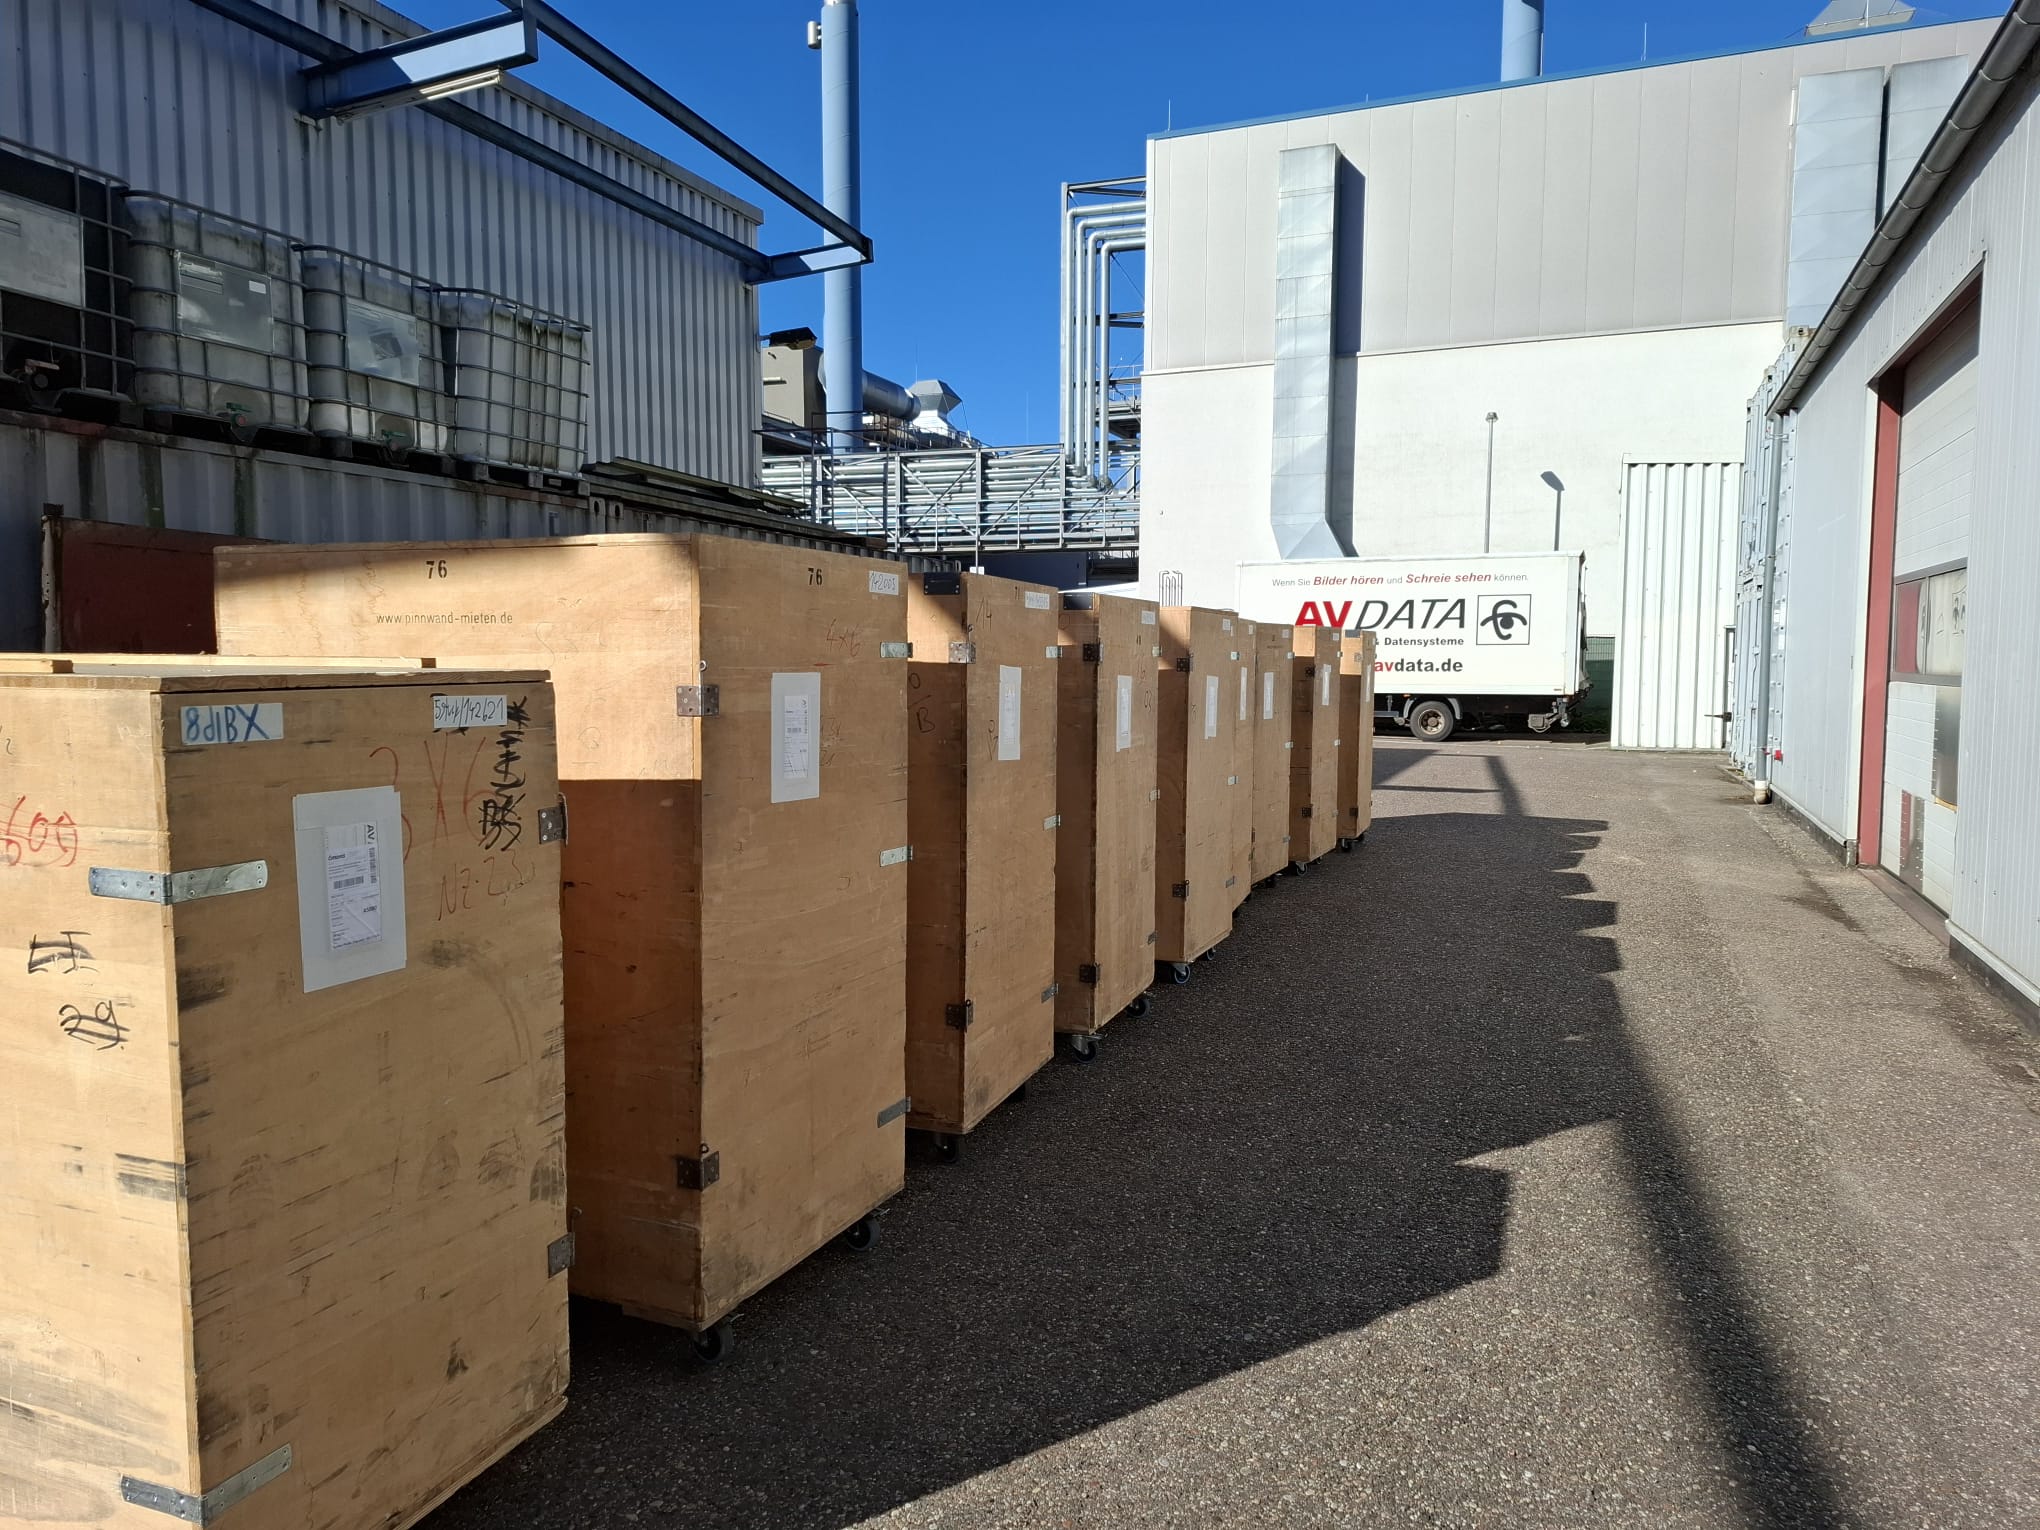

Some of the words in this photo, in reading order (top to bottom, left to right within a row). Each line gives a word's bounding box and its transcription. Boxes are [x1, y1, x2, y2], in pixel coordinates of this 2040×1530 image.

[426, 560, 447, 579] 76
[808, 567, 823, 586] 76
[1272, 578, 1295, 587] Wenn
[1297, 578, 1311, 586] Sie
[1313, 576, 1347, 586] Bilder
[1350, 575, 1384, 585] hören
[1386, 576, 1403, 584] und
[1406, 573, 1451, 583] Schreie
[1454, 572, 1491, 582] sehen
[1384, 637, 1465, 648] Datensysteme
[1374, 658, 1464, 673] avdata.de
[367, 824, 376, 844] AV
